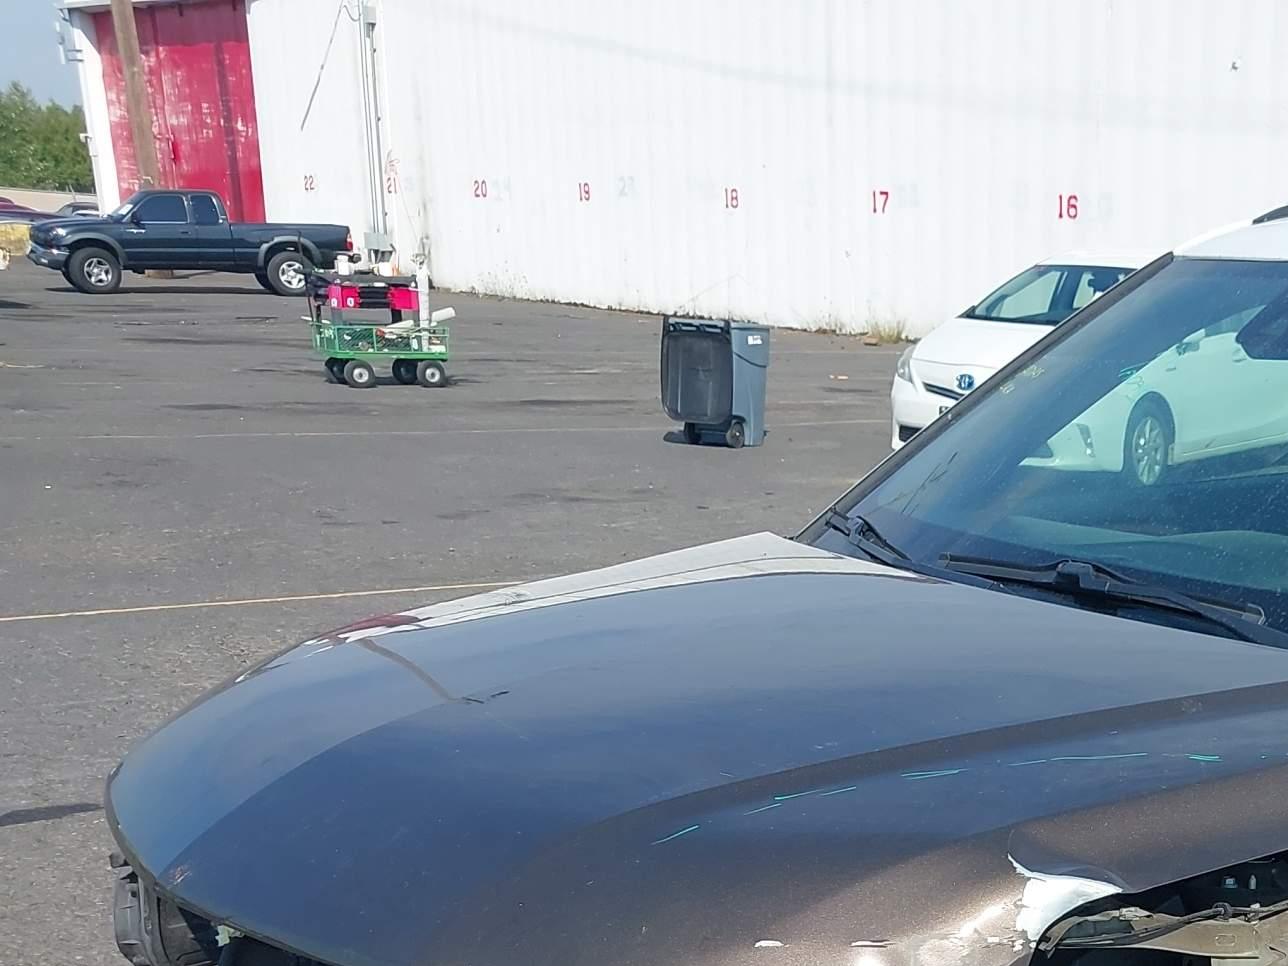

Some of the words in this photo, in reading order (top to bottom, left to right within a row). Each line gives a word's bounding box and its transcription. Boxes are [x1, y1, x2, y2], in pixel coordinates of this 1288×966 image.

[303, 175, 315, 192] 22
[473, 180, 488, 198] 20
[578, 182, 591, 202] 19
[724, 188, 739, 209] 18
[872, 190, 889, 214] 17
[1058, 194, 1079, 220] 16
